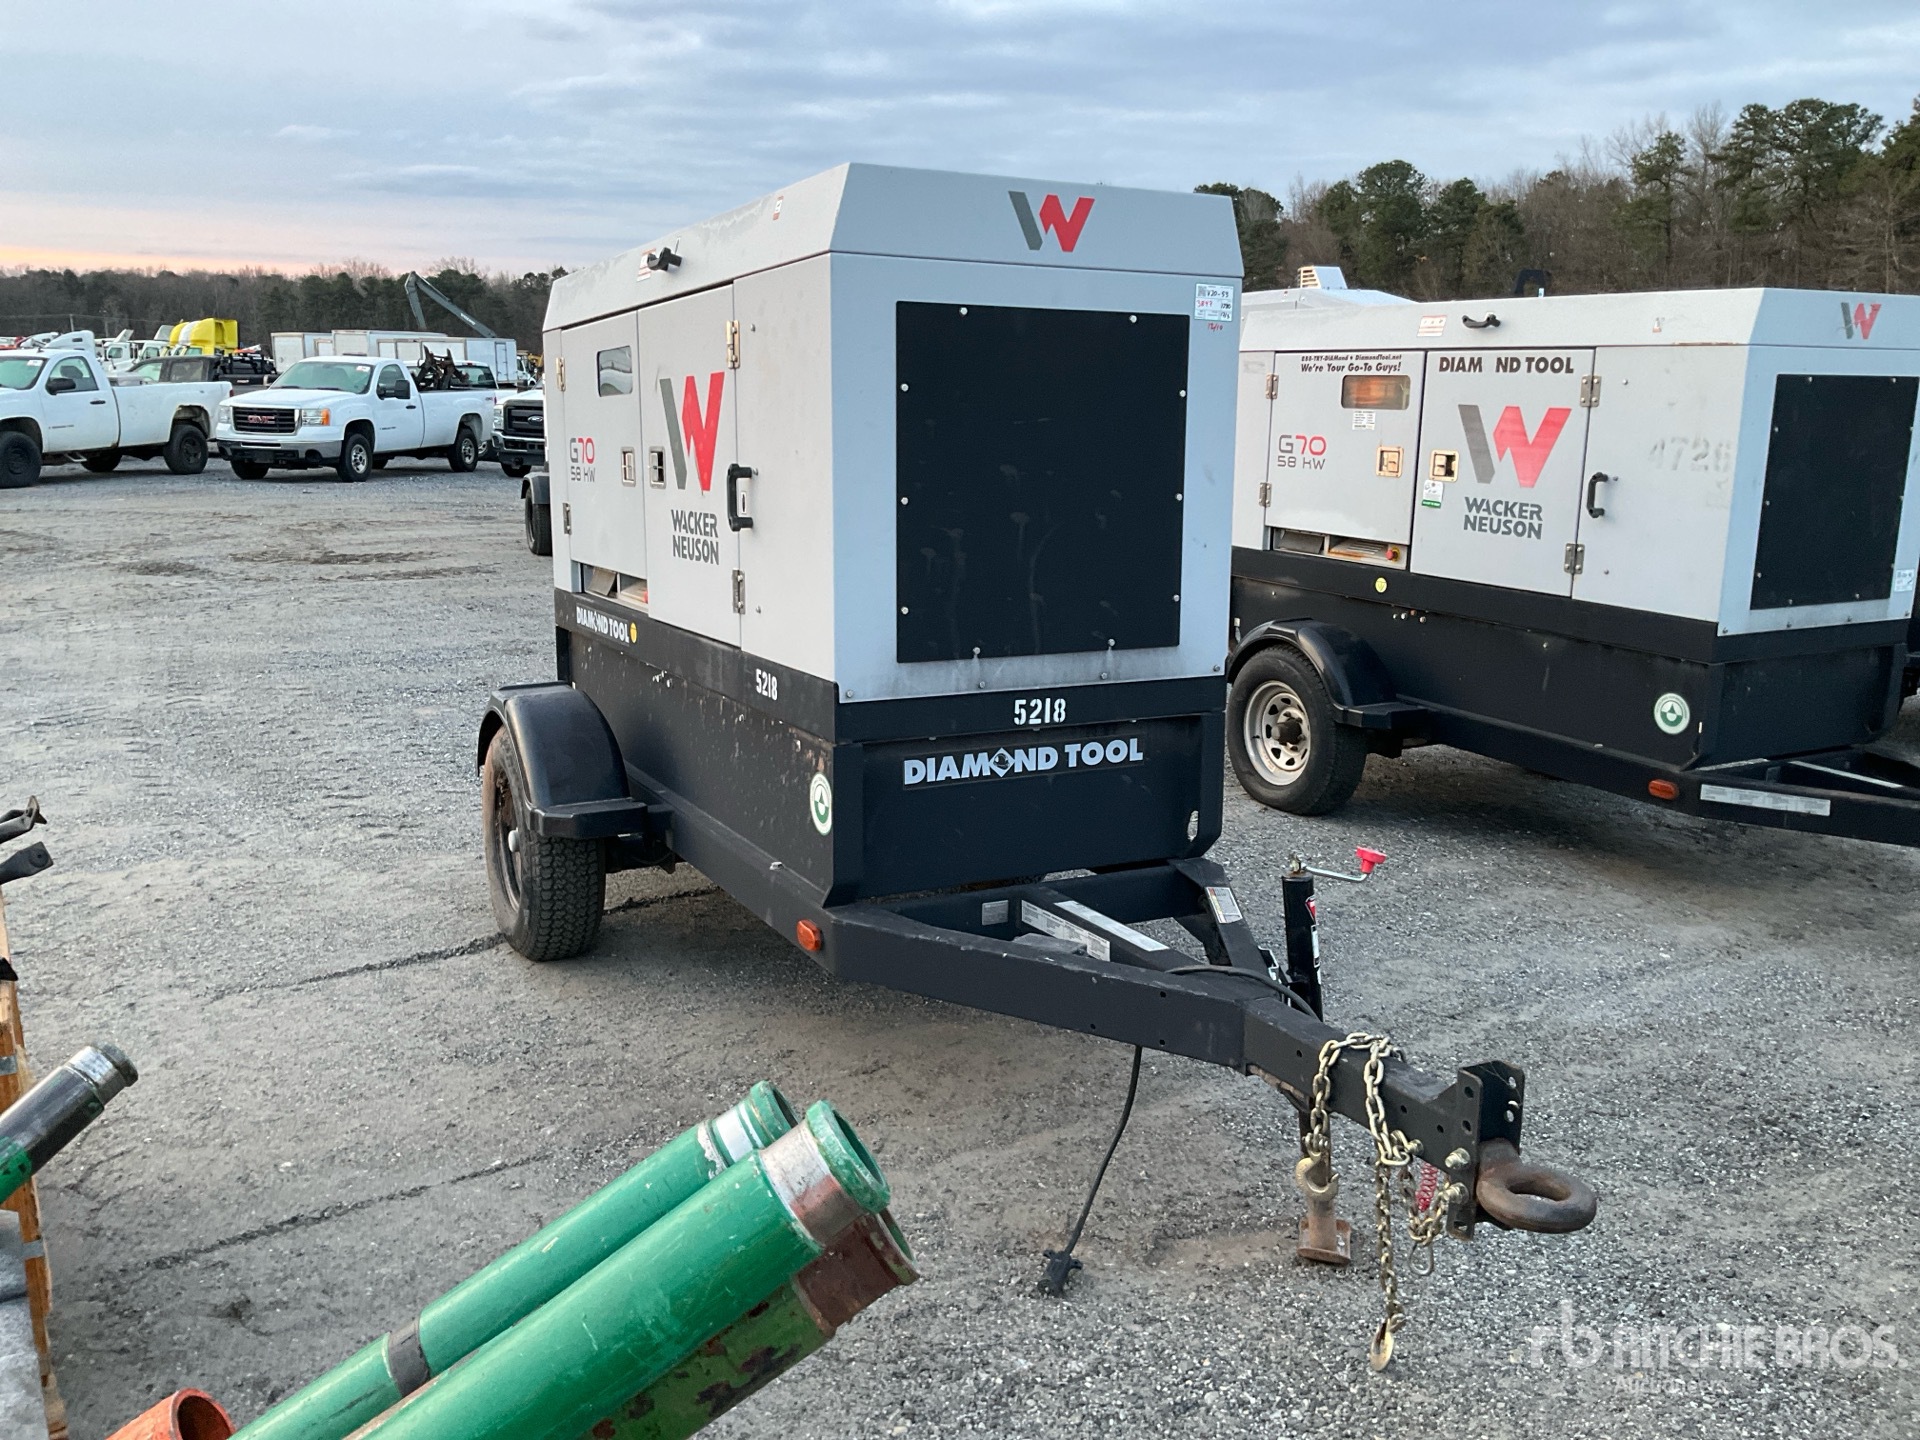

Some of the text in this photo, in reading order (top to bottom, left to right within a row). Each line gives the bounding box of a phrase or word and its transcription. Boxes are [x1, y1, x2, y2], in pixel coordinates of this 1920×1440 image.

[1301, 361, 1401, 374] We're Your Go-To Guys!
[1525, 357, 1574, 374] TOOL
[570, 437, 595, 464] G70
[1279, 434, 1327, 456] G70
[571, 466, 581, 481] 58
[1277, 455, 1297, 468] 58
[1464, 496, 1543, 521] WACKER
[671, 509, 719, 538] WACKER
[1463, 514, 1543, 540] NEUSON
[672, 534, 720, 565] NEUSON
[609, 618, 630, 643] TOOL
[755, 668, 778, 701] 5218
[1013, 698, 1067, 725] 5218
[1064, 738, 1144, 768] TOOL
